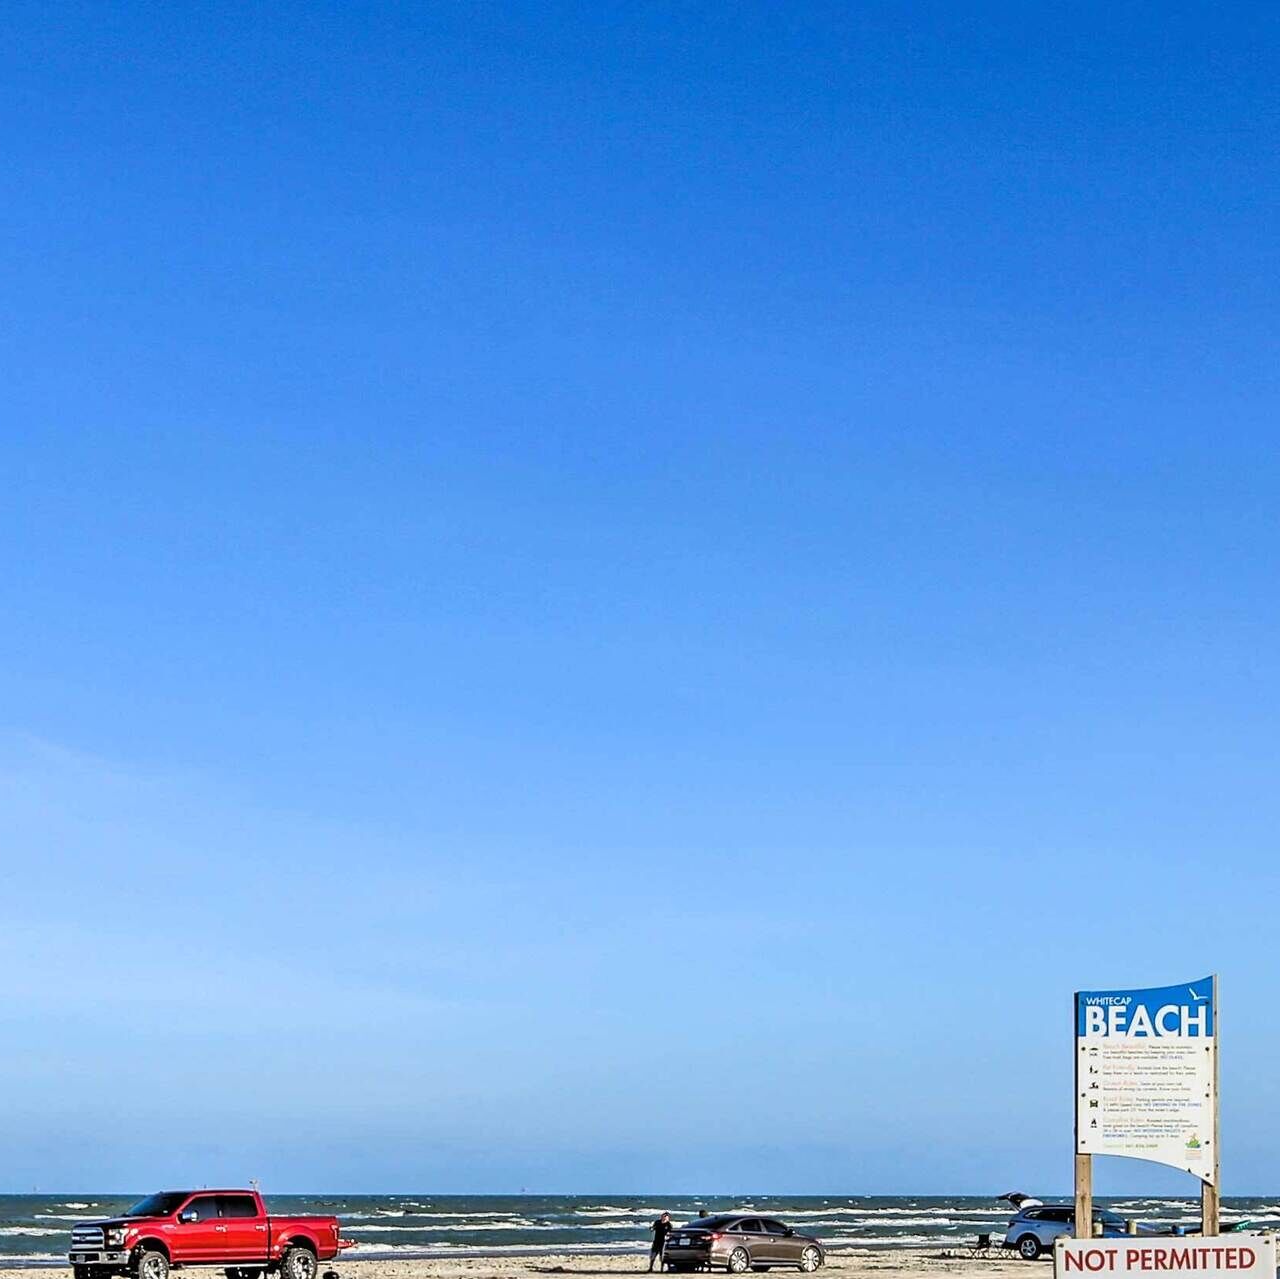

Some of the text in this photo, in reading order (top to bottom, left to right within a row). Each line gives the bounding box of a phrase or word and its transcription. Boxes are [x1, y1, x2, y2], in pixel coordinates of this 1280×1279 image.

[1086, 997, 1132, 1005] WHITECAP
[1085, 1005, 1207, 1037] BEACH
[1064, 1248, 1256, 1271] NOT PERMITTED
